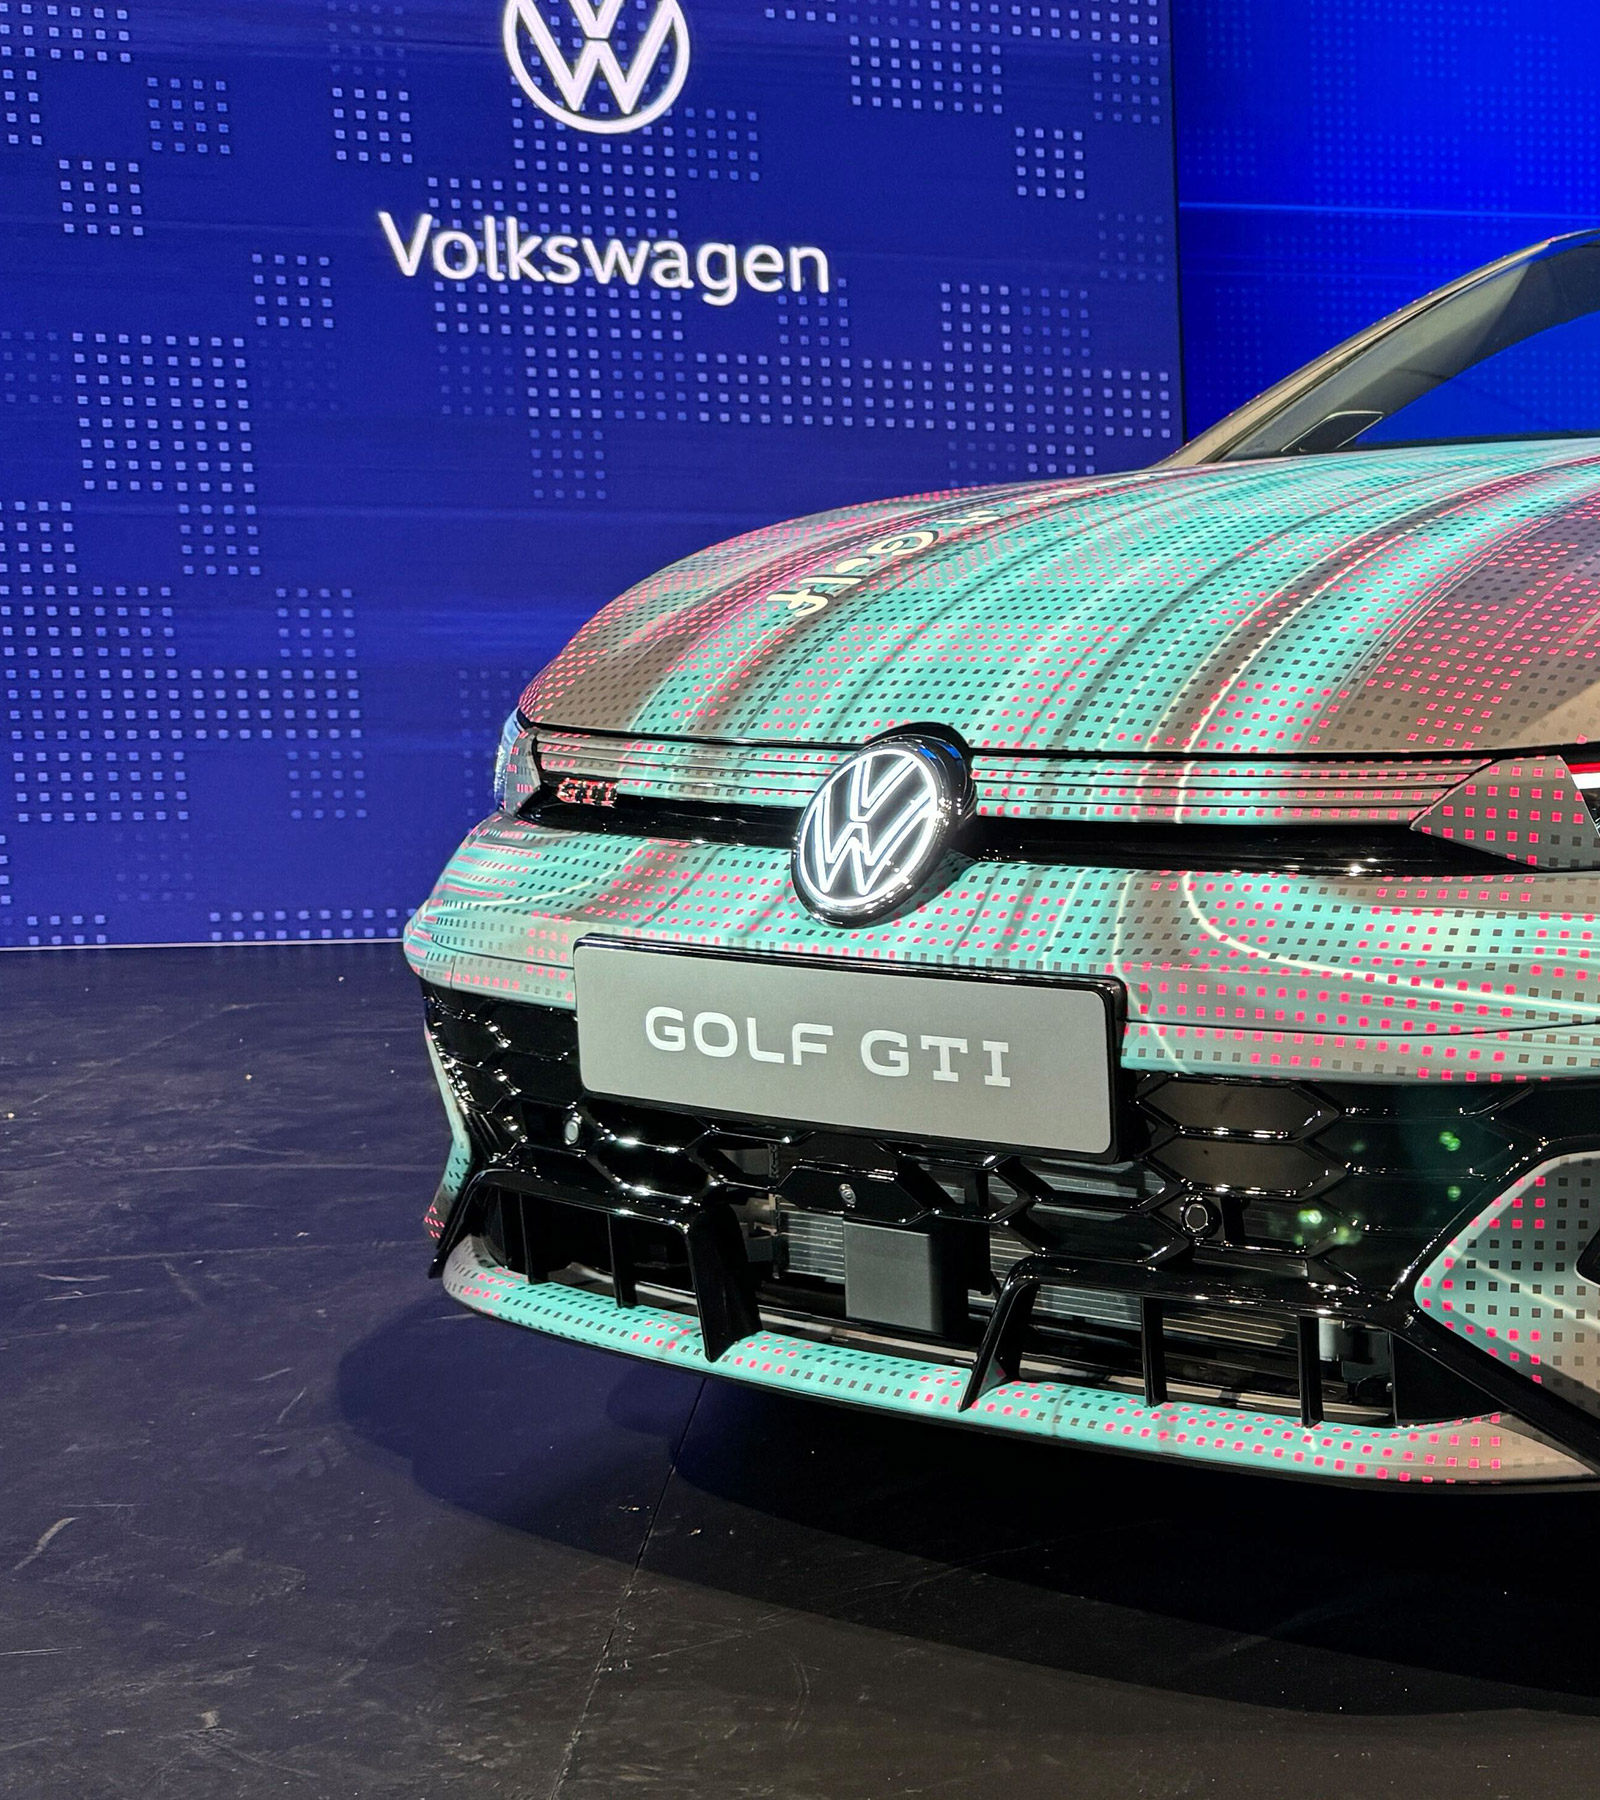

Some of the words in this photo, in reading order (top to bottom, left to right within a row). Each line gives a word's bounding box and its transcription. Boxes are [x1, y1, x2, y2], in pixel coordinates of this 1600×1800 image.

[378, 211, 830, 306] Volkswagen
[556, 777, 619, 808] GTI
[804, 750, 936, 900] VW
[645, 1005, 835, 1067] GOLF
[860, 1028, 1012, 1088] GTI
